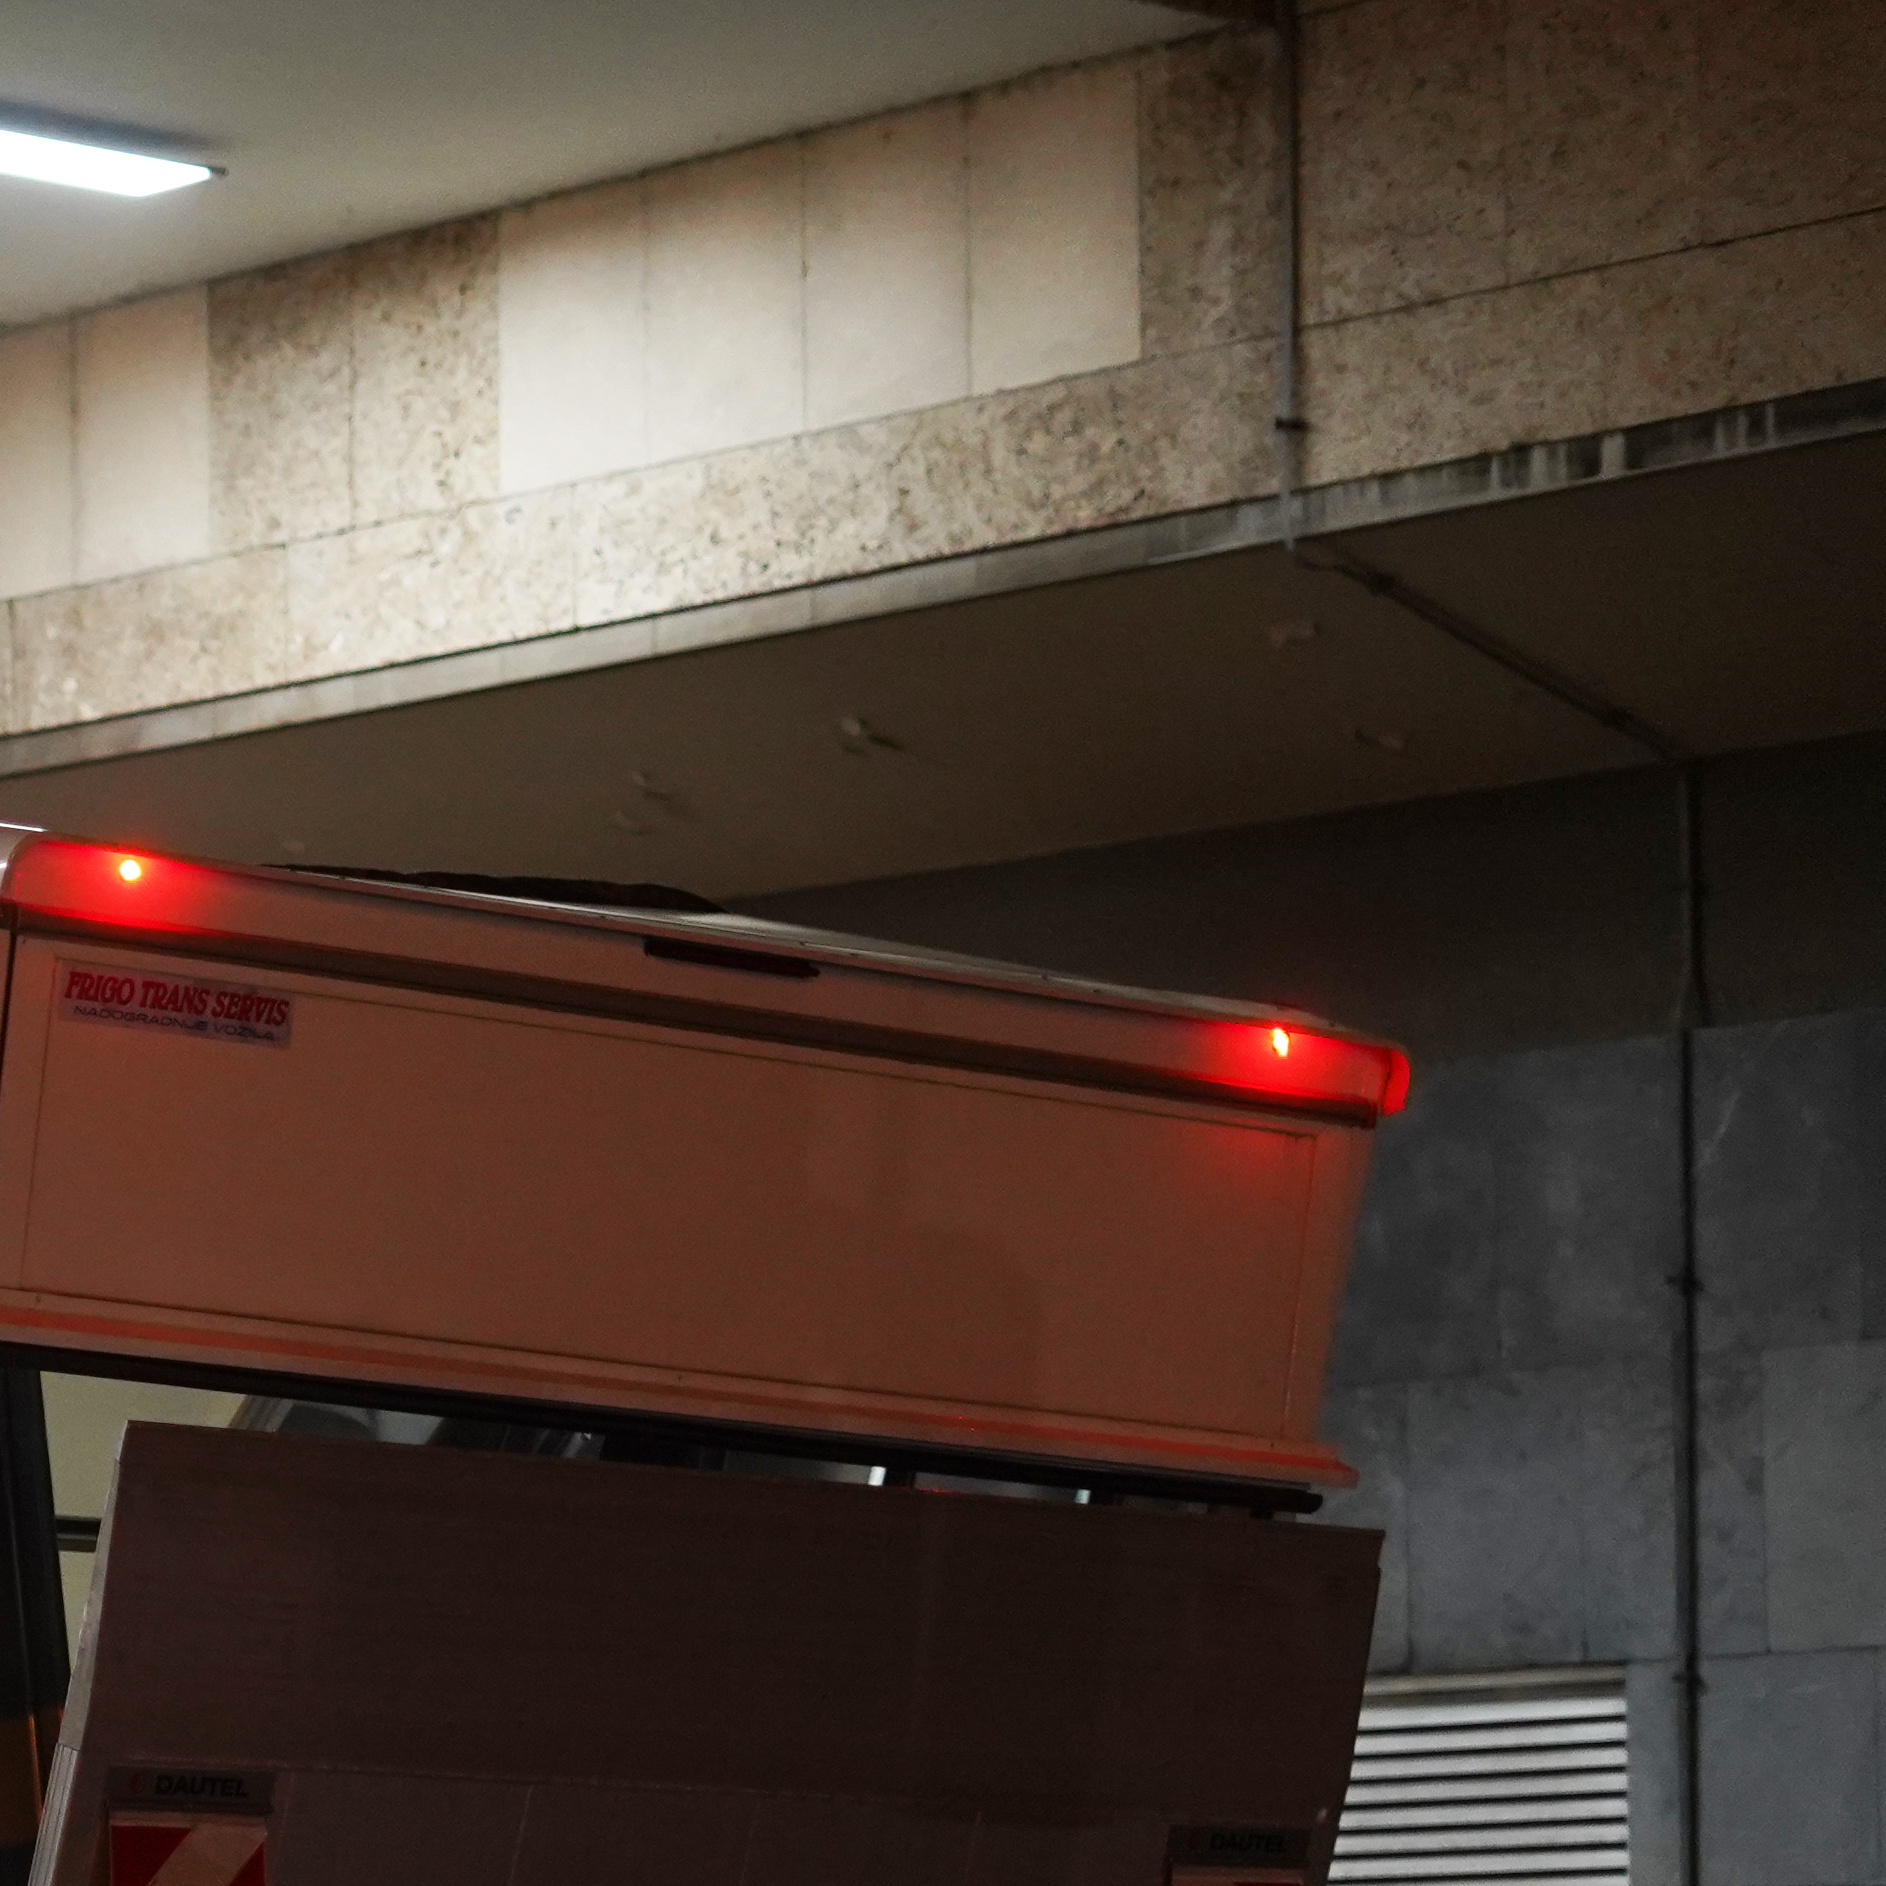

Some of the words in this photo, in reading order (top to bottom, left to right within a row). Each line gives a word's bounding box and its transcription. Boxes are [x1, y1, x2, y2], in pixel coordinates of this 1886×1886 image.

[64, 971, 136, 1006] FRIGO
[139, 980, 211, 1017] TRANS
[211, 990, 290, 1026] SERVIS
[155, 1775, 249, 1798] DAUTEL
[1210, 1833, 1287, 1853] DAUTEL
